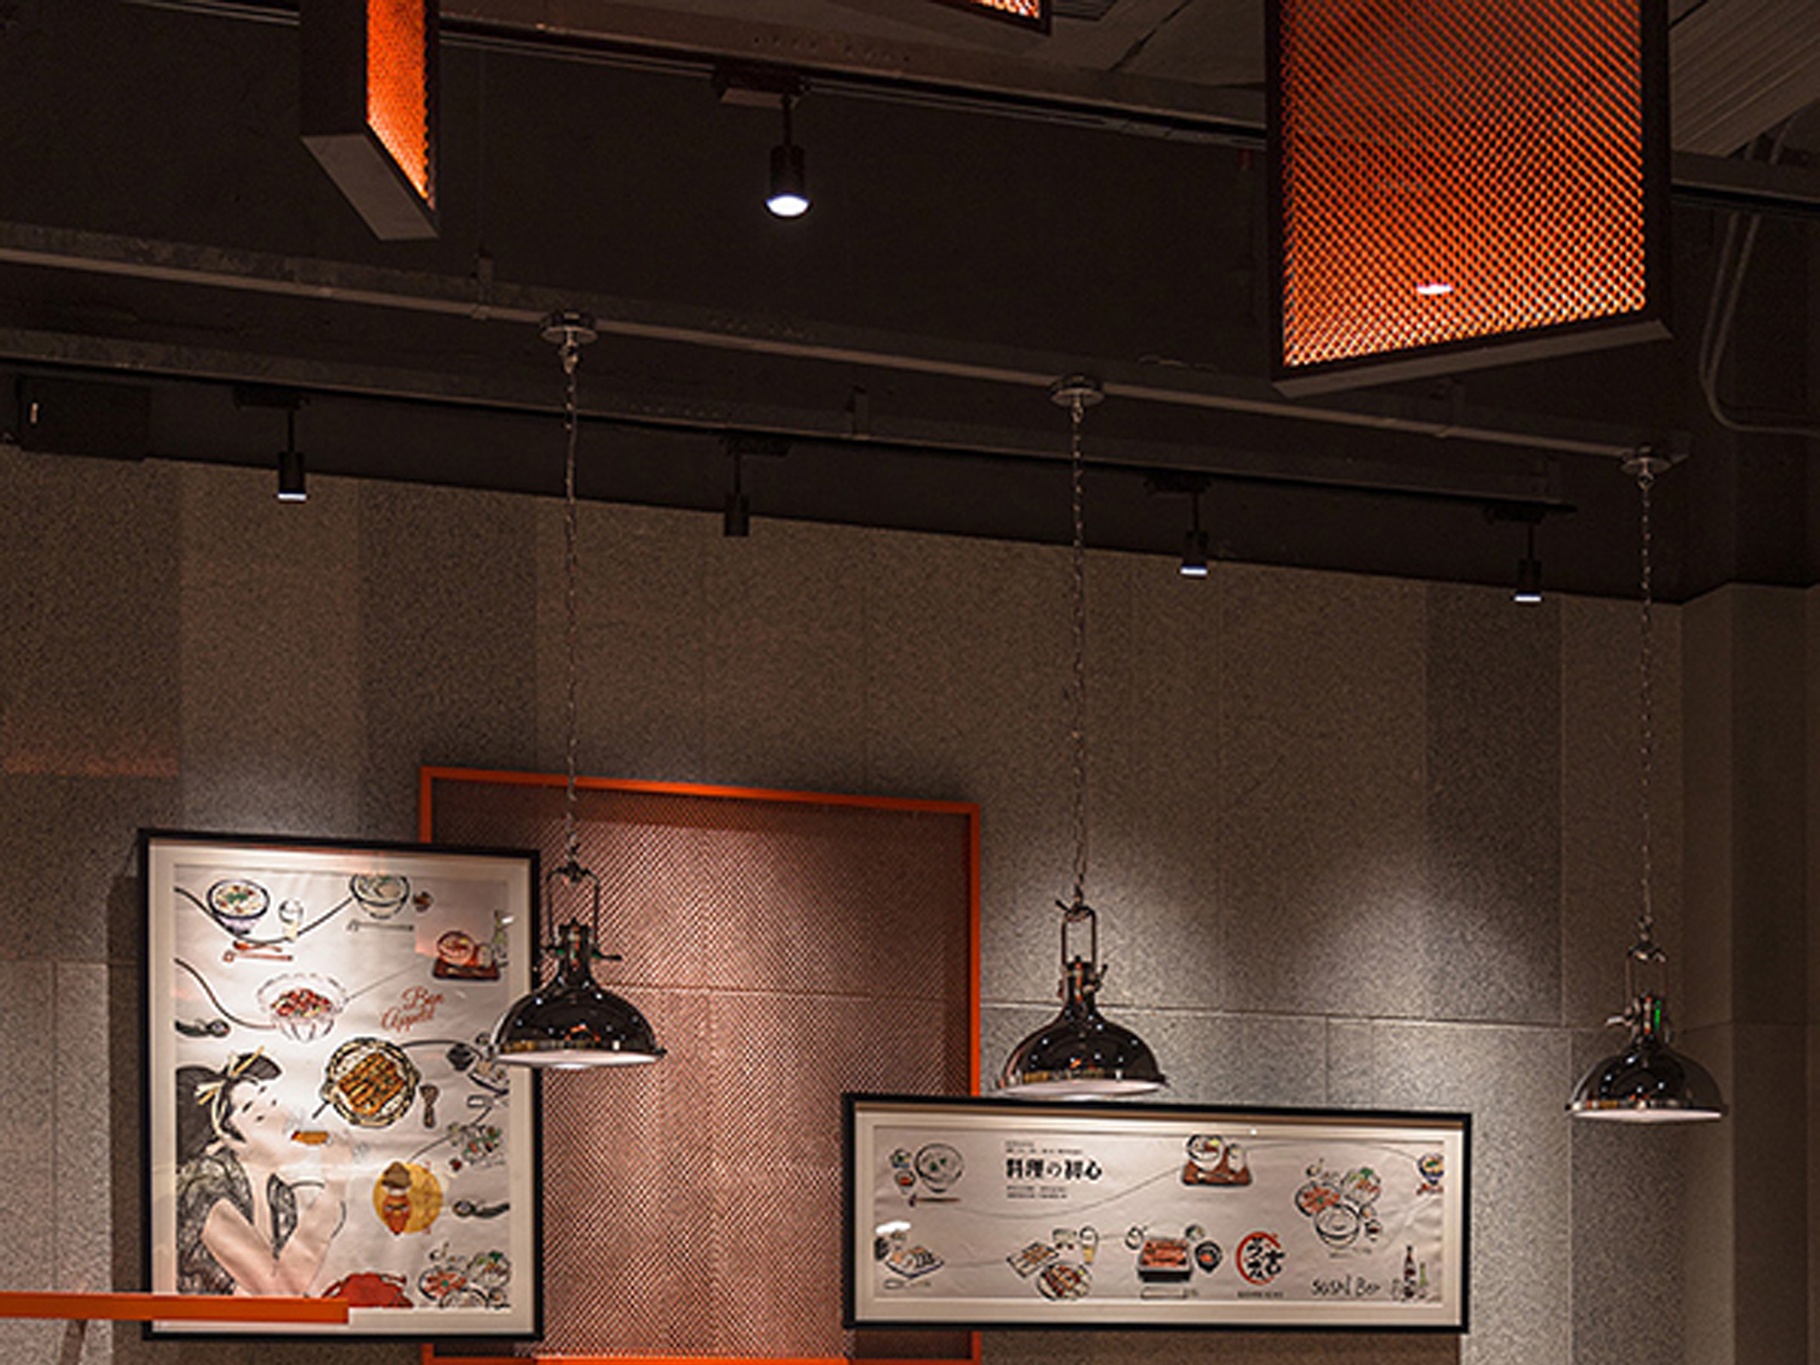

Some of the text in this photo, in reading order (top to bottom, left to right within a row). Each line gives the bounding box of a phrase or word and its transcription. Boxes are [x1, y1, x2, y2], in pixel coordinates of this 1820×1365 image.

[1006, 1158, 1102, 1181] 料理の初心
